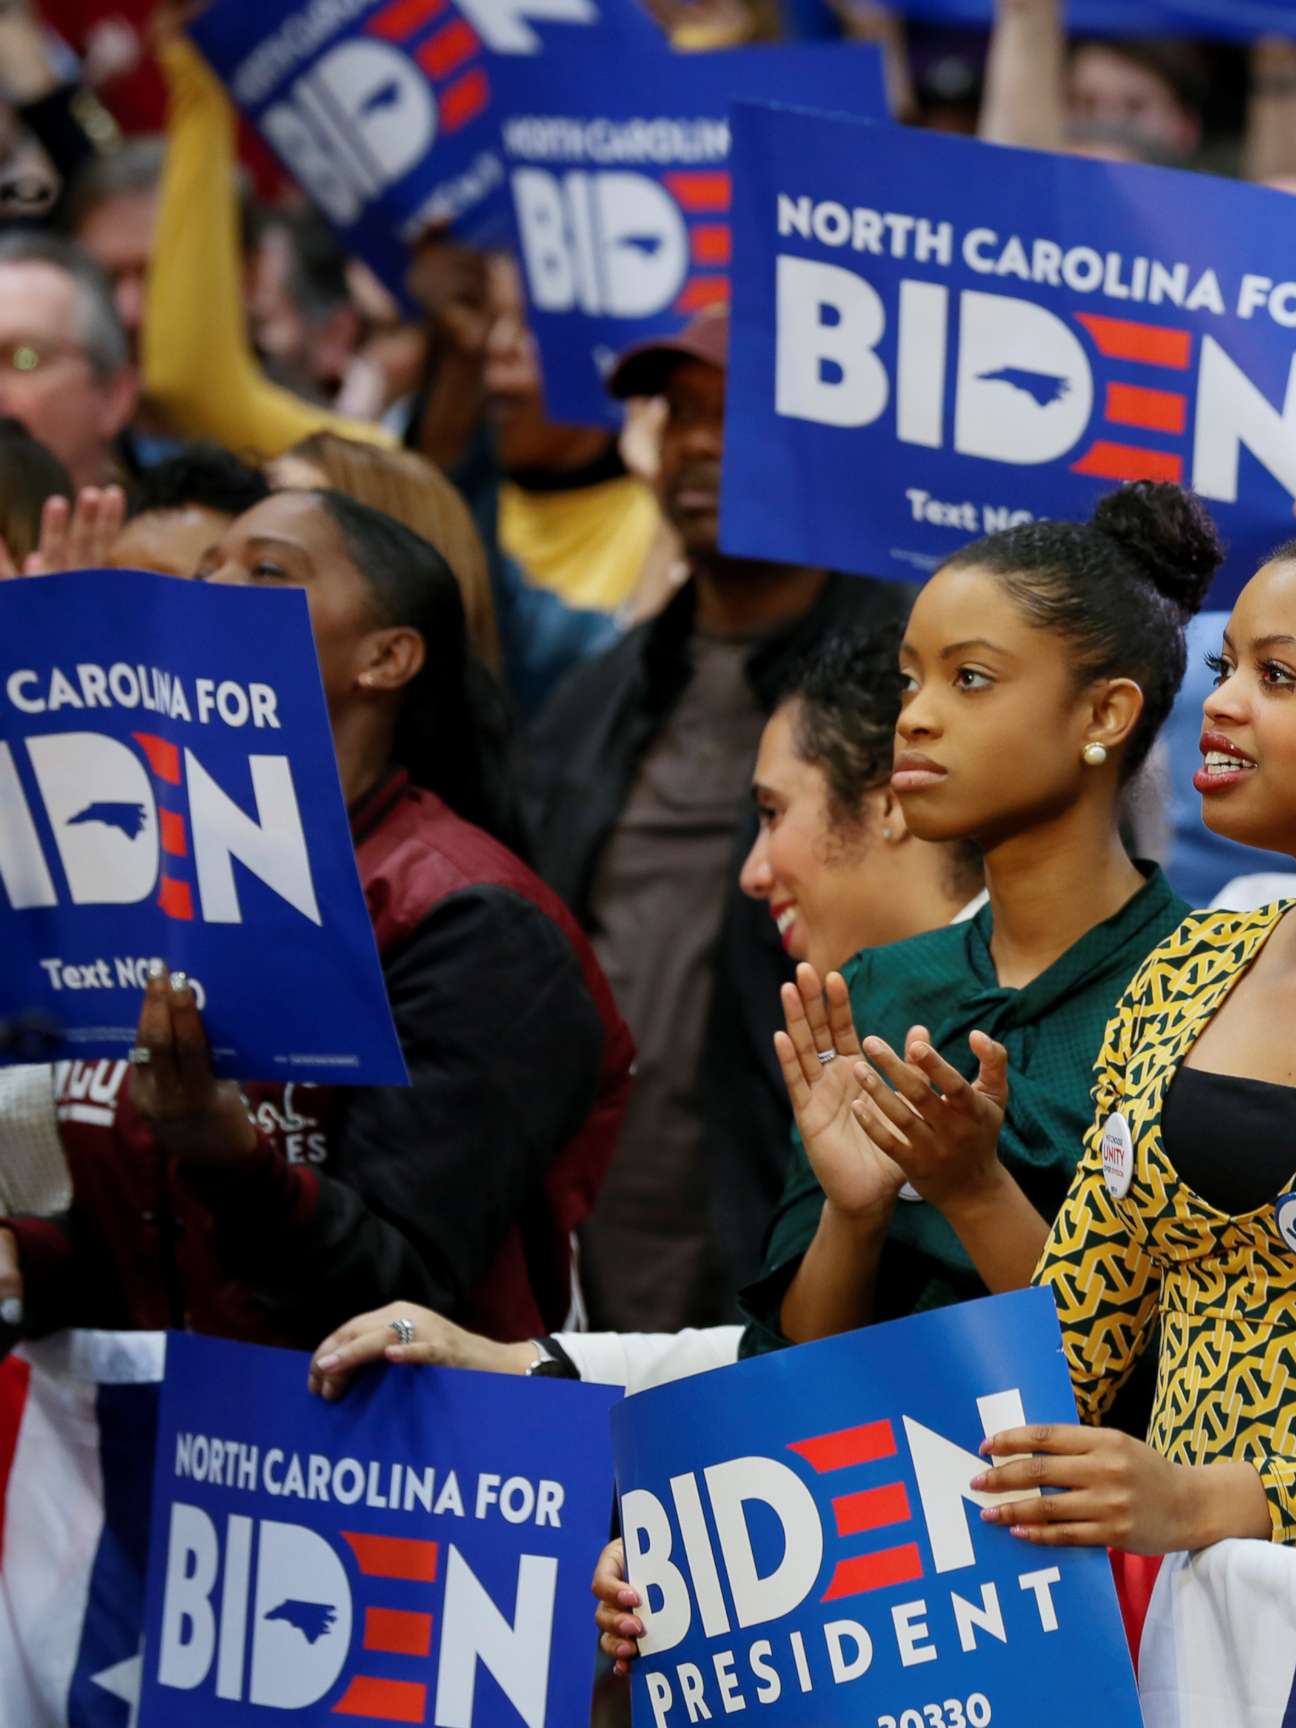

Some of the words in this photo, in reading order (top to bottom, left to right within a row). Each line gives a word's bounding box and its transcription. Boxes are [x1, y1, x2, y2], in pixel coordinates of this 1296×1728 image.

[511, 167, 731, 320] BIDE
[776, 194, 953, 267] NORTH
[962, 228, 1226, 317] CAROLINA
[906, 487, 978, 532] Text
[6, 662, 192, 722] CAROLINA
[196, 678, 281, 728] FOR
[0, 731, 323, 928] IDEN
[40, 957, 114, 990] Text
[1103, 1143, 1126, 1166] UNITY
[175, 1432, 258, 1491] NORTH
[262, 1448, 465, 1518] CAROLINA
[474, 1473, 566, 1528] FOR
[620, 1388, 1041, 1657] BIDEN
[157, 1502, 559, 1728] BIDEN
[645, 1565, 1062, 1728] PRESIDENT
